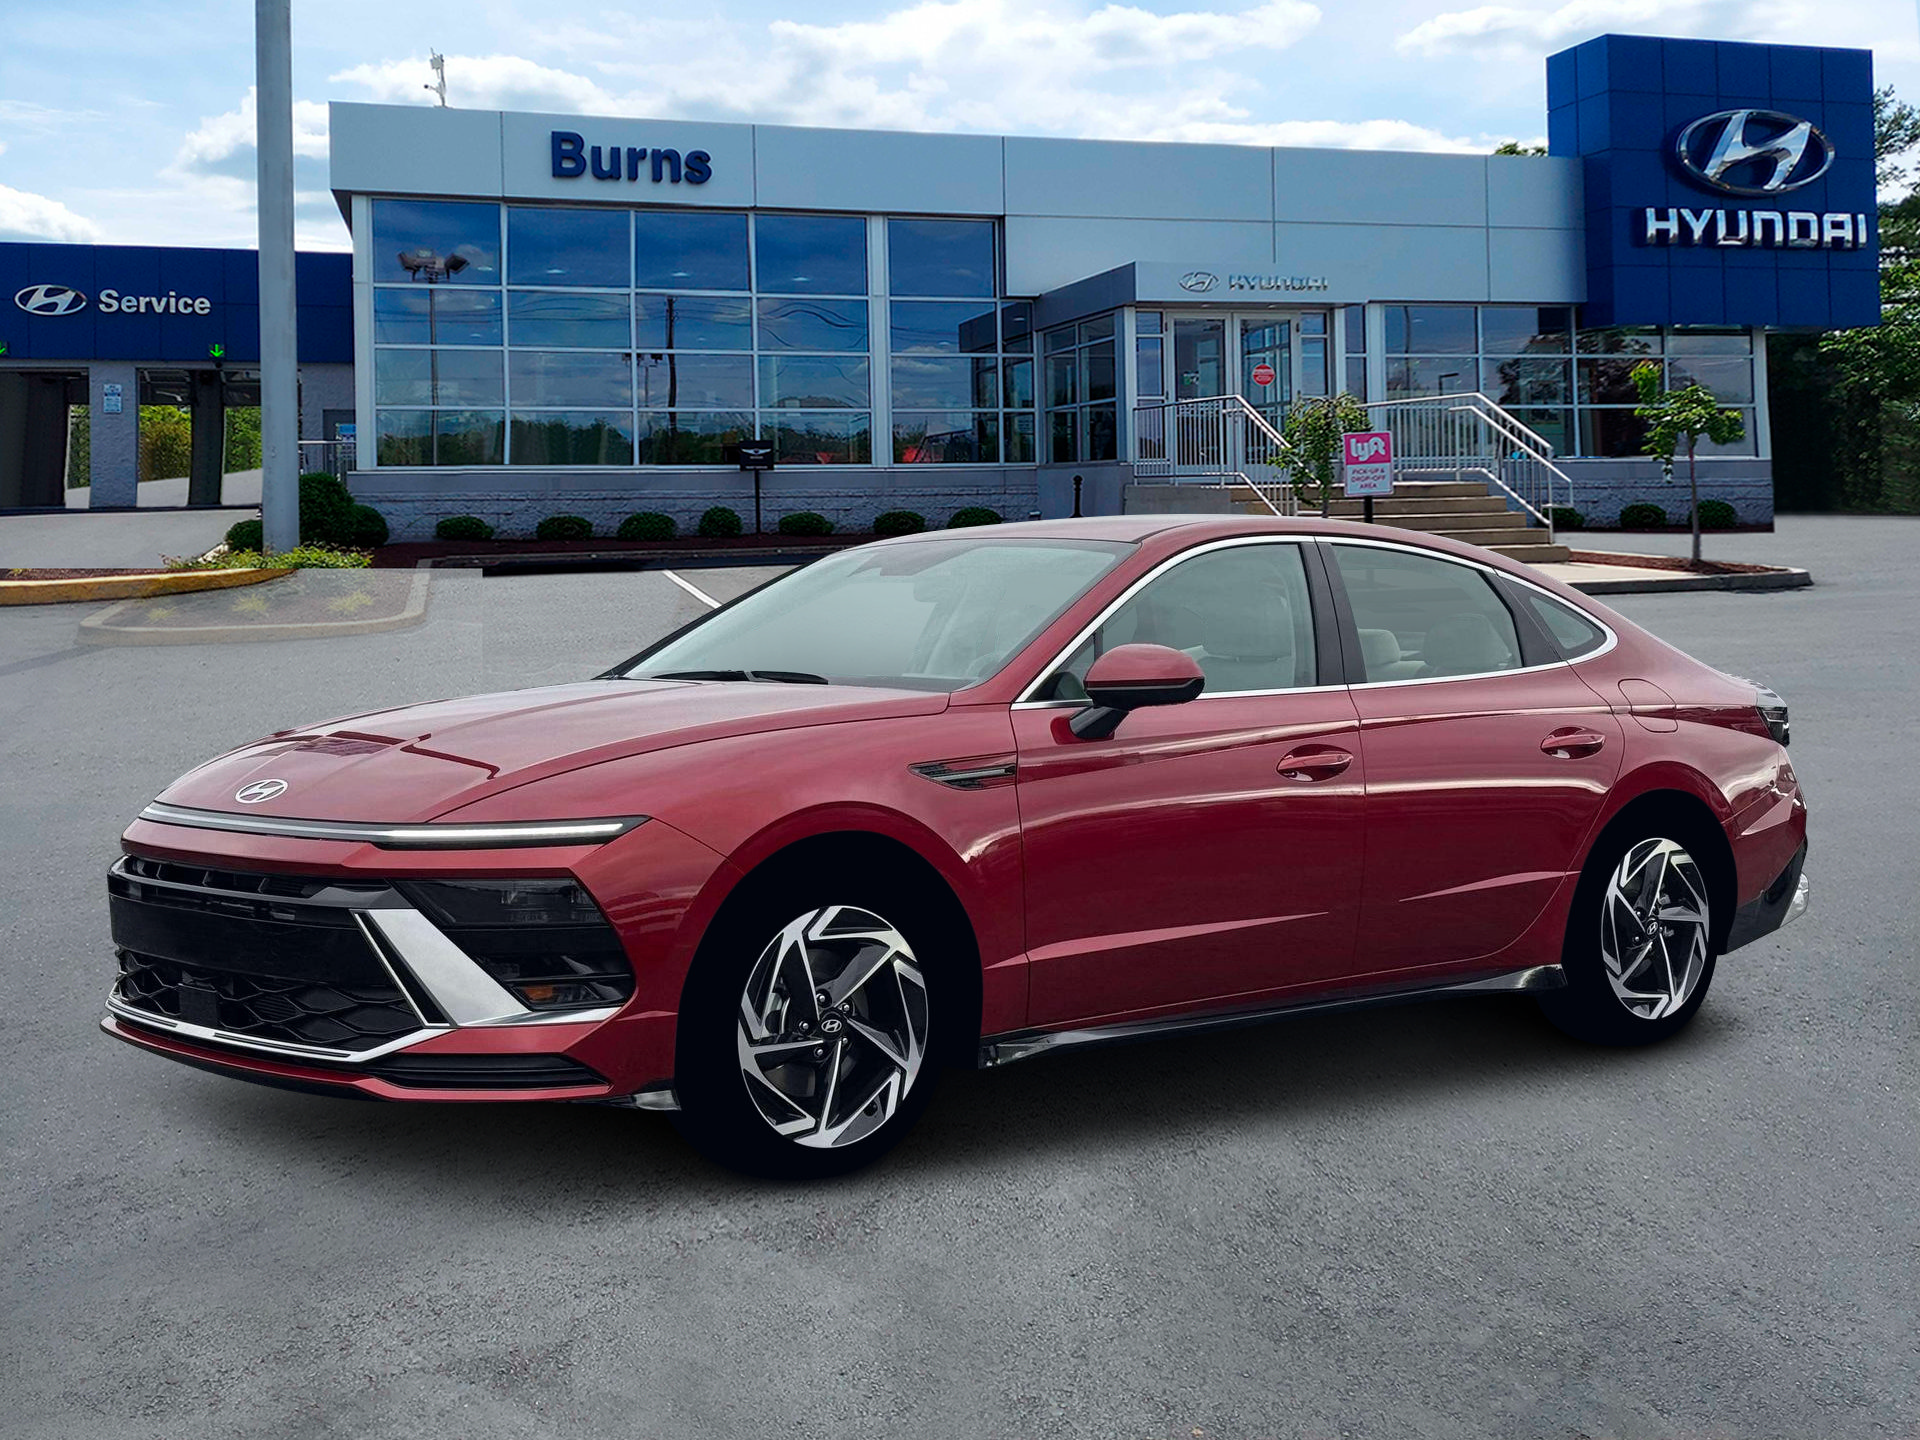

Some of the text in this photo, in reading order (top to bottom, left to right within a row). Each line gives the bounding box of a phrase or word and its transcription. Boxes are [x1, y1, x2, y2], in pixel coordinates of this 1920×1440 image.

[550, 130, 712, 184] Burns
[1645, 206, 1868, 249] HYUNDAI
[1228, 274, 1328, 292] HYUNDAI
[98, 288, 212, 315] Service
